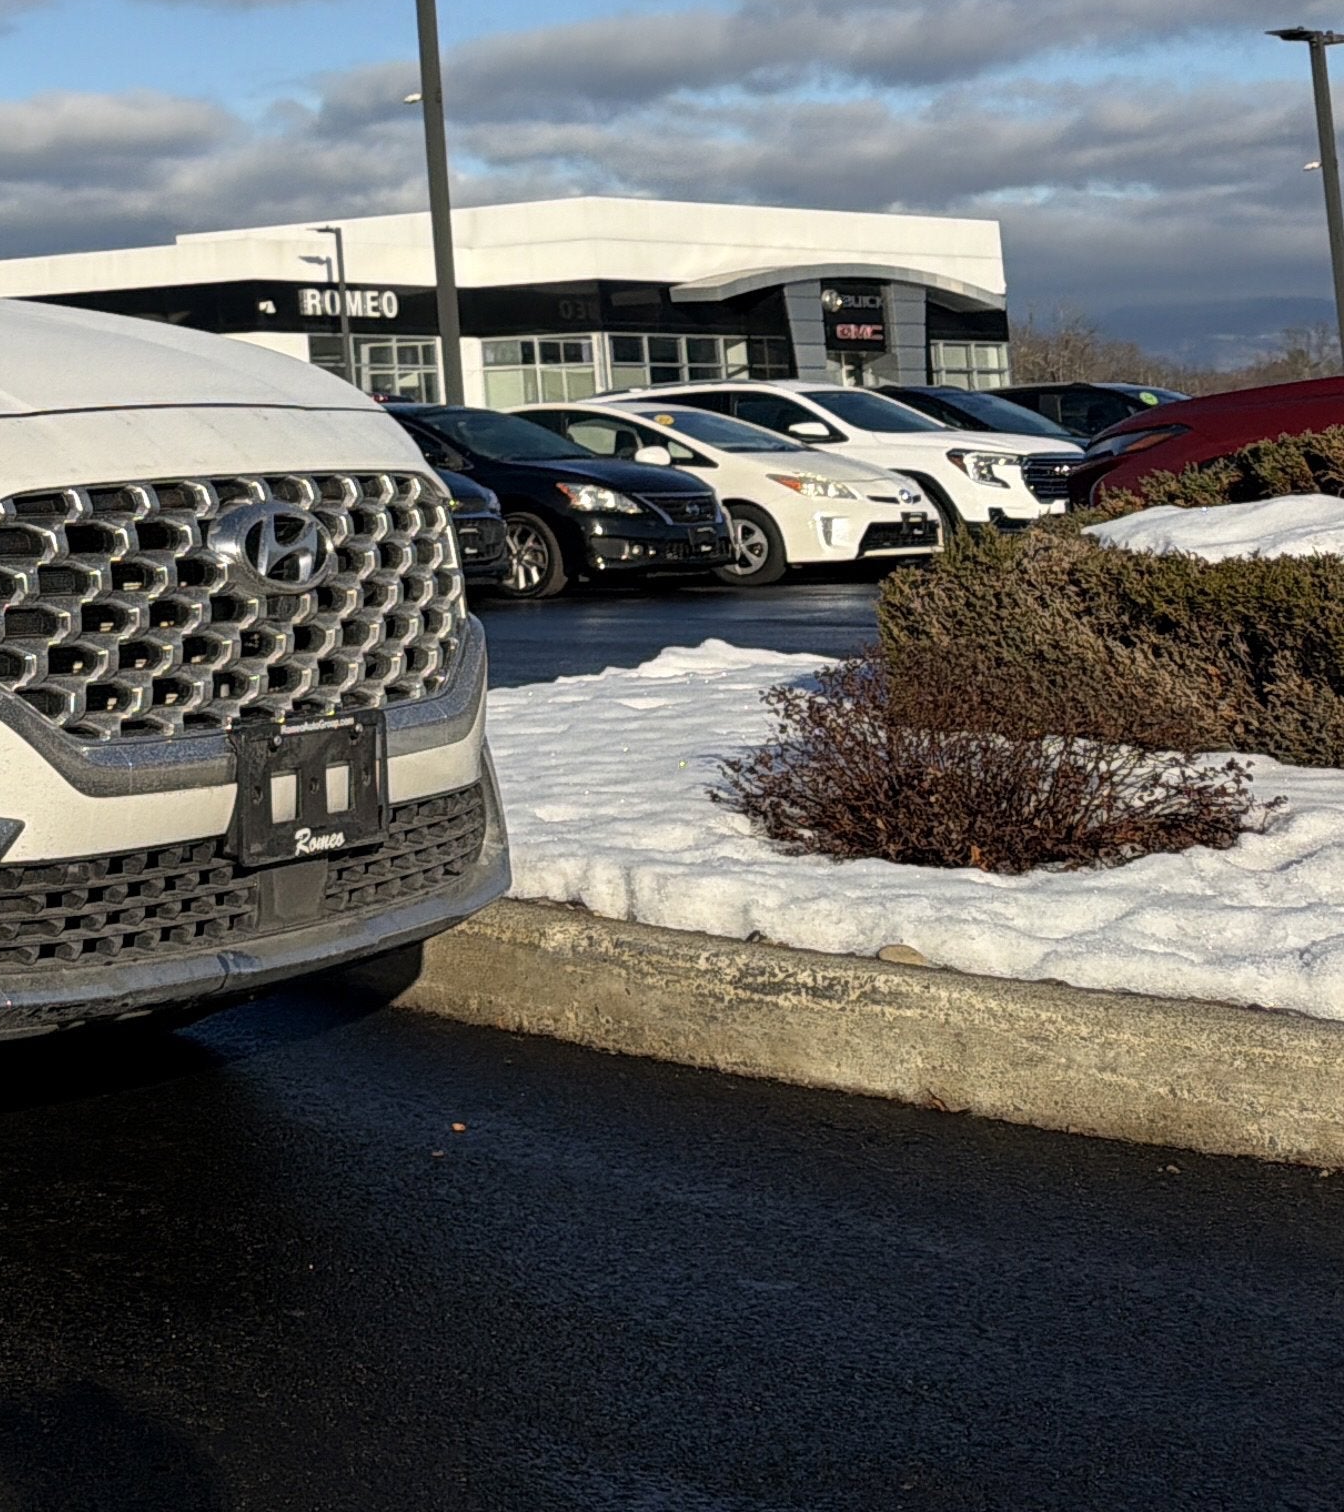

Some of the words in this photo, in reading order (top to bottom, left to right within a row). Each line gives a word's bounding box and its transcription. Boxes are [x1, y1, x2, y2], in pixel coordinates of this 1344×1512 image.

[300, 289, 398, 319] ROMEO
[836, 323, 883, 340] GMC
[294, 828, 345, 856] Romeo
